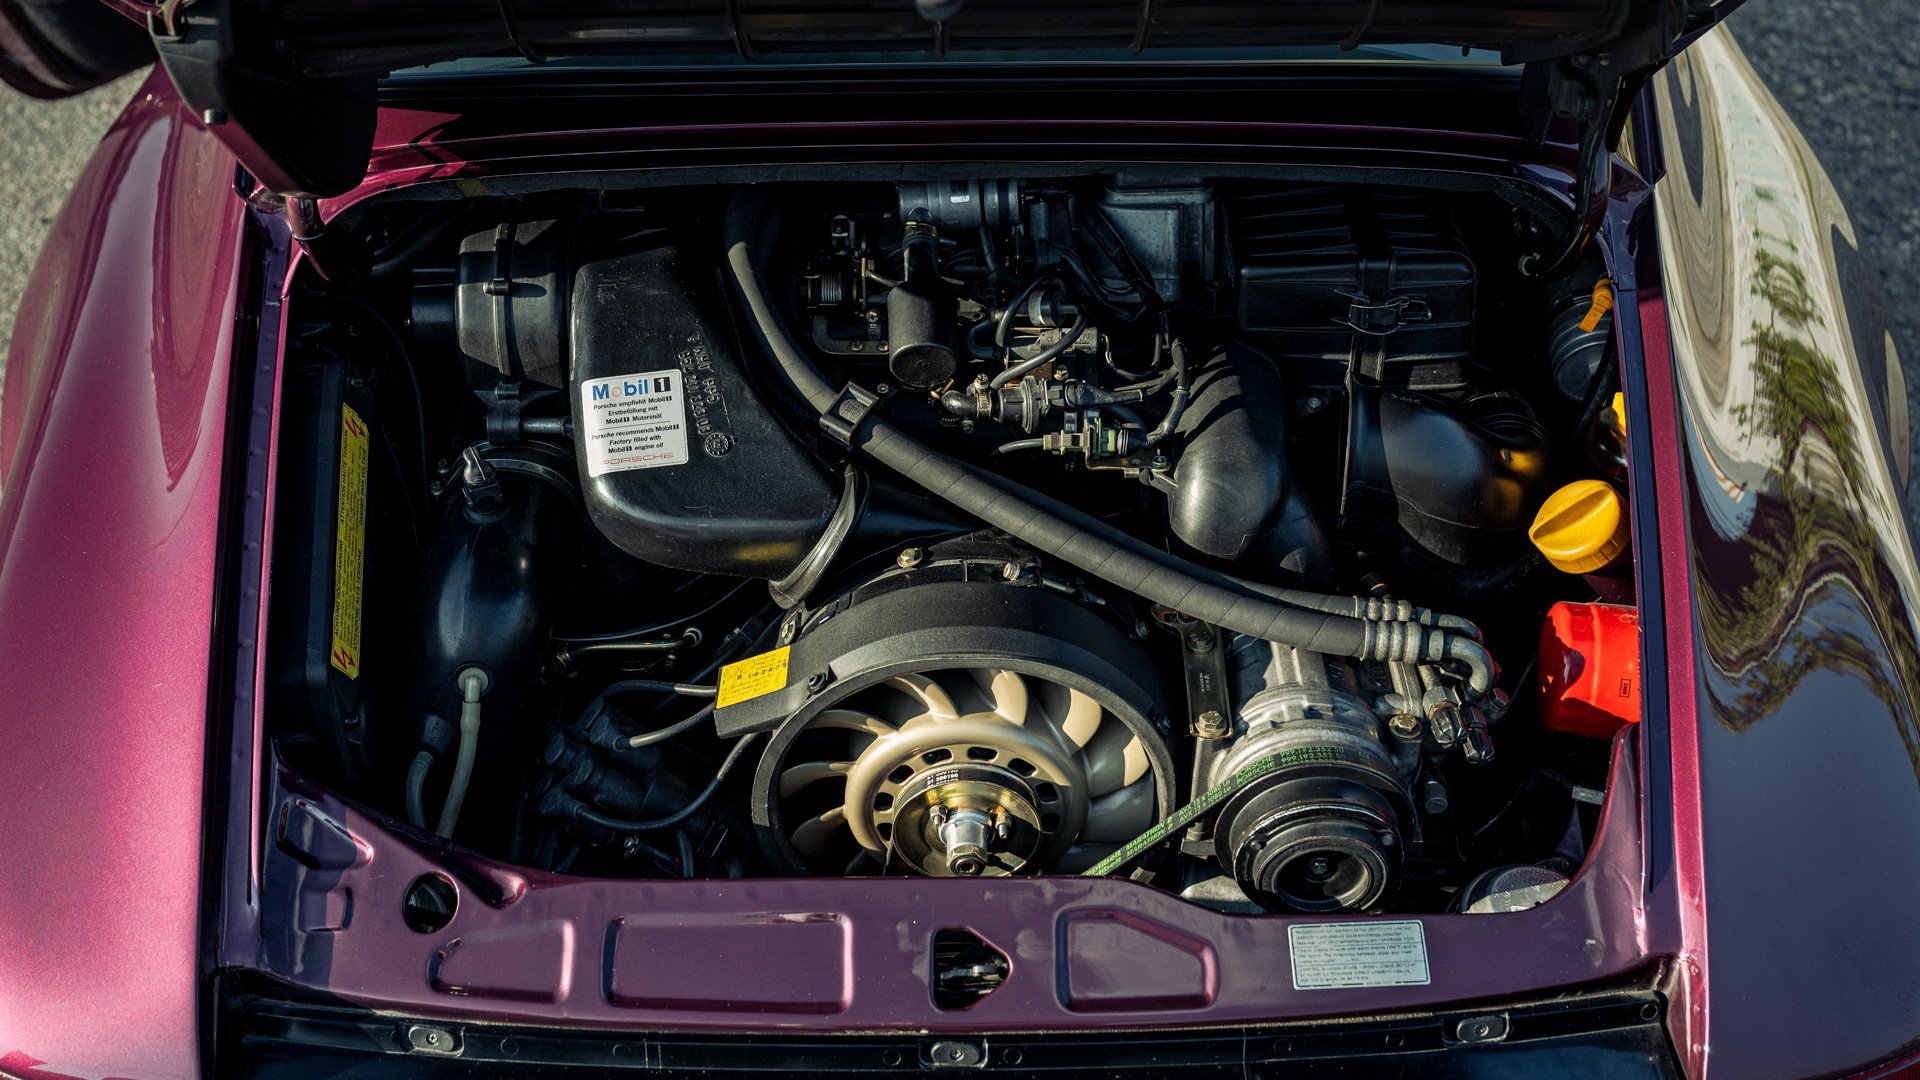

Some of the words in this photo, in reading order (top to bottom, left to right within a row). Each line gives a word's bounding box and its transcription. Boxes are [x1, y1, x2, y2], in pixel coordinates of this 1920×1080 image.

[592, 379, 648, 400] Mobil
[618, 399, 646, 407] empfiehlt
[608, 407, 647, 416] Erstbefüllung
[632, 413, 662, 422] Motorenöl
[616, 427, 654, 436] recommends
[609, 438, 632, 446] Factory
[634, 444, 655, 452] engine
[601, 453, 674, 464] PORSCHE
[1125, 820, 1165, 851] MARATHON
[1179, 803, 1192, 817] AVX
[1207, 785, 1221, 797] 1080
[1236, 755, 1274, 778] PORSCHE
[1126, 827, 1166, 857] MARATHON
[1180, 810, 1192, 822] AVX
[1208, 790, 1222, 803] 1080
[1237, 762, 1275, 787] PORSCHE
